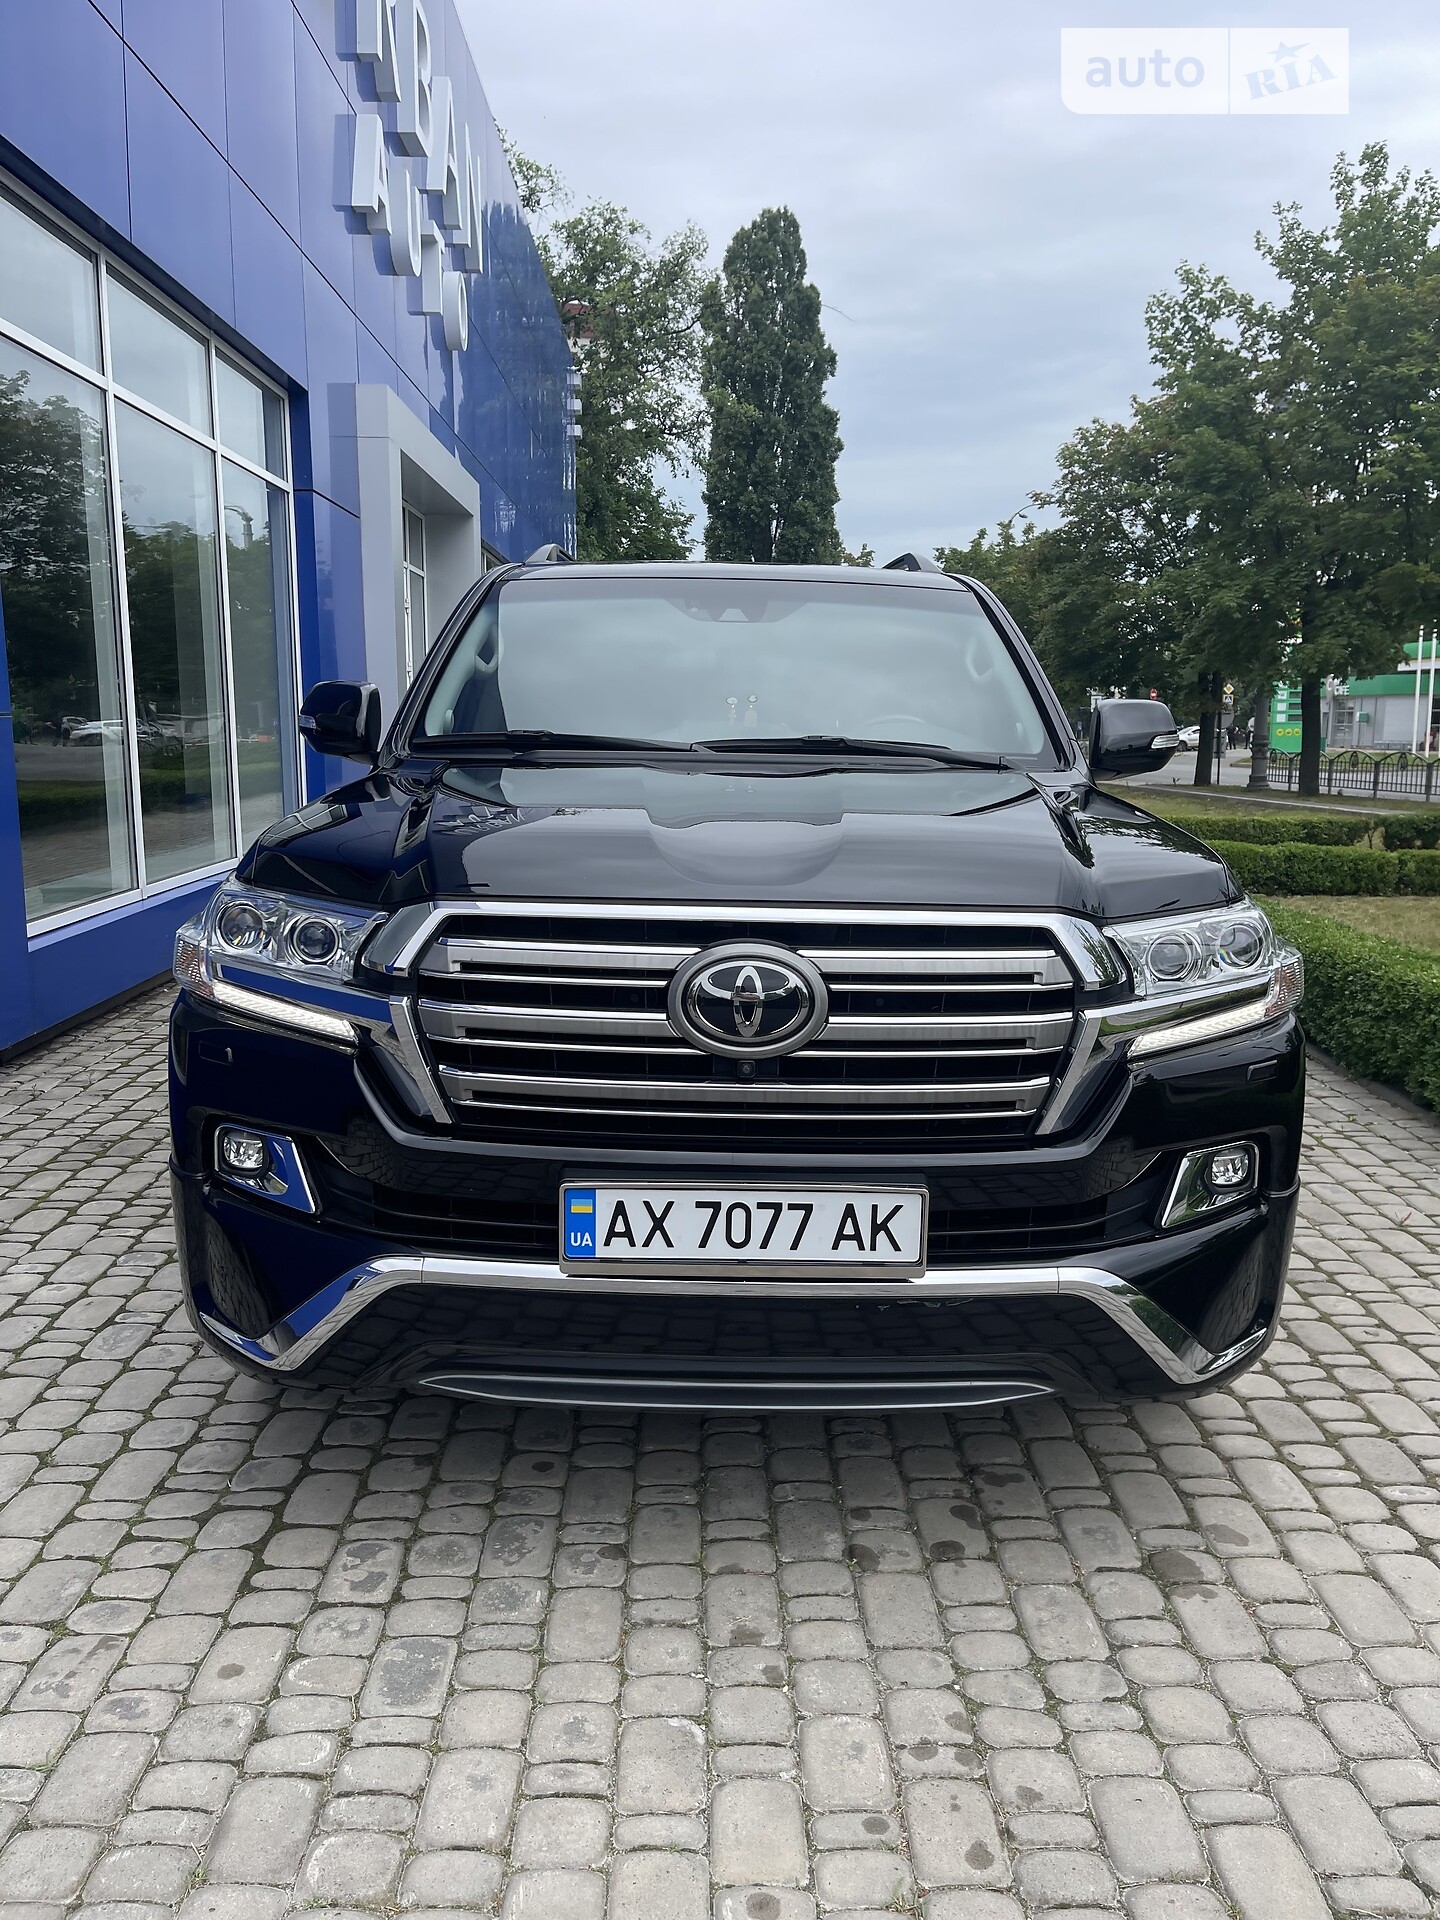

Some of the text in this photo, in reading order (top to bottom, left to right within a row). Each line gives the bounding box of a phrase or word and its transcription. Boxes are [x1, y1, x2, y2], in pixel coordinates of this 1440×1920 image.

[352, 114, 468, 351] AUTO
[569, 1231, 593, 1248] UA
[603, 1200, 904, 1252] AX 7077 AK
